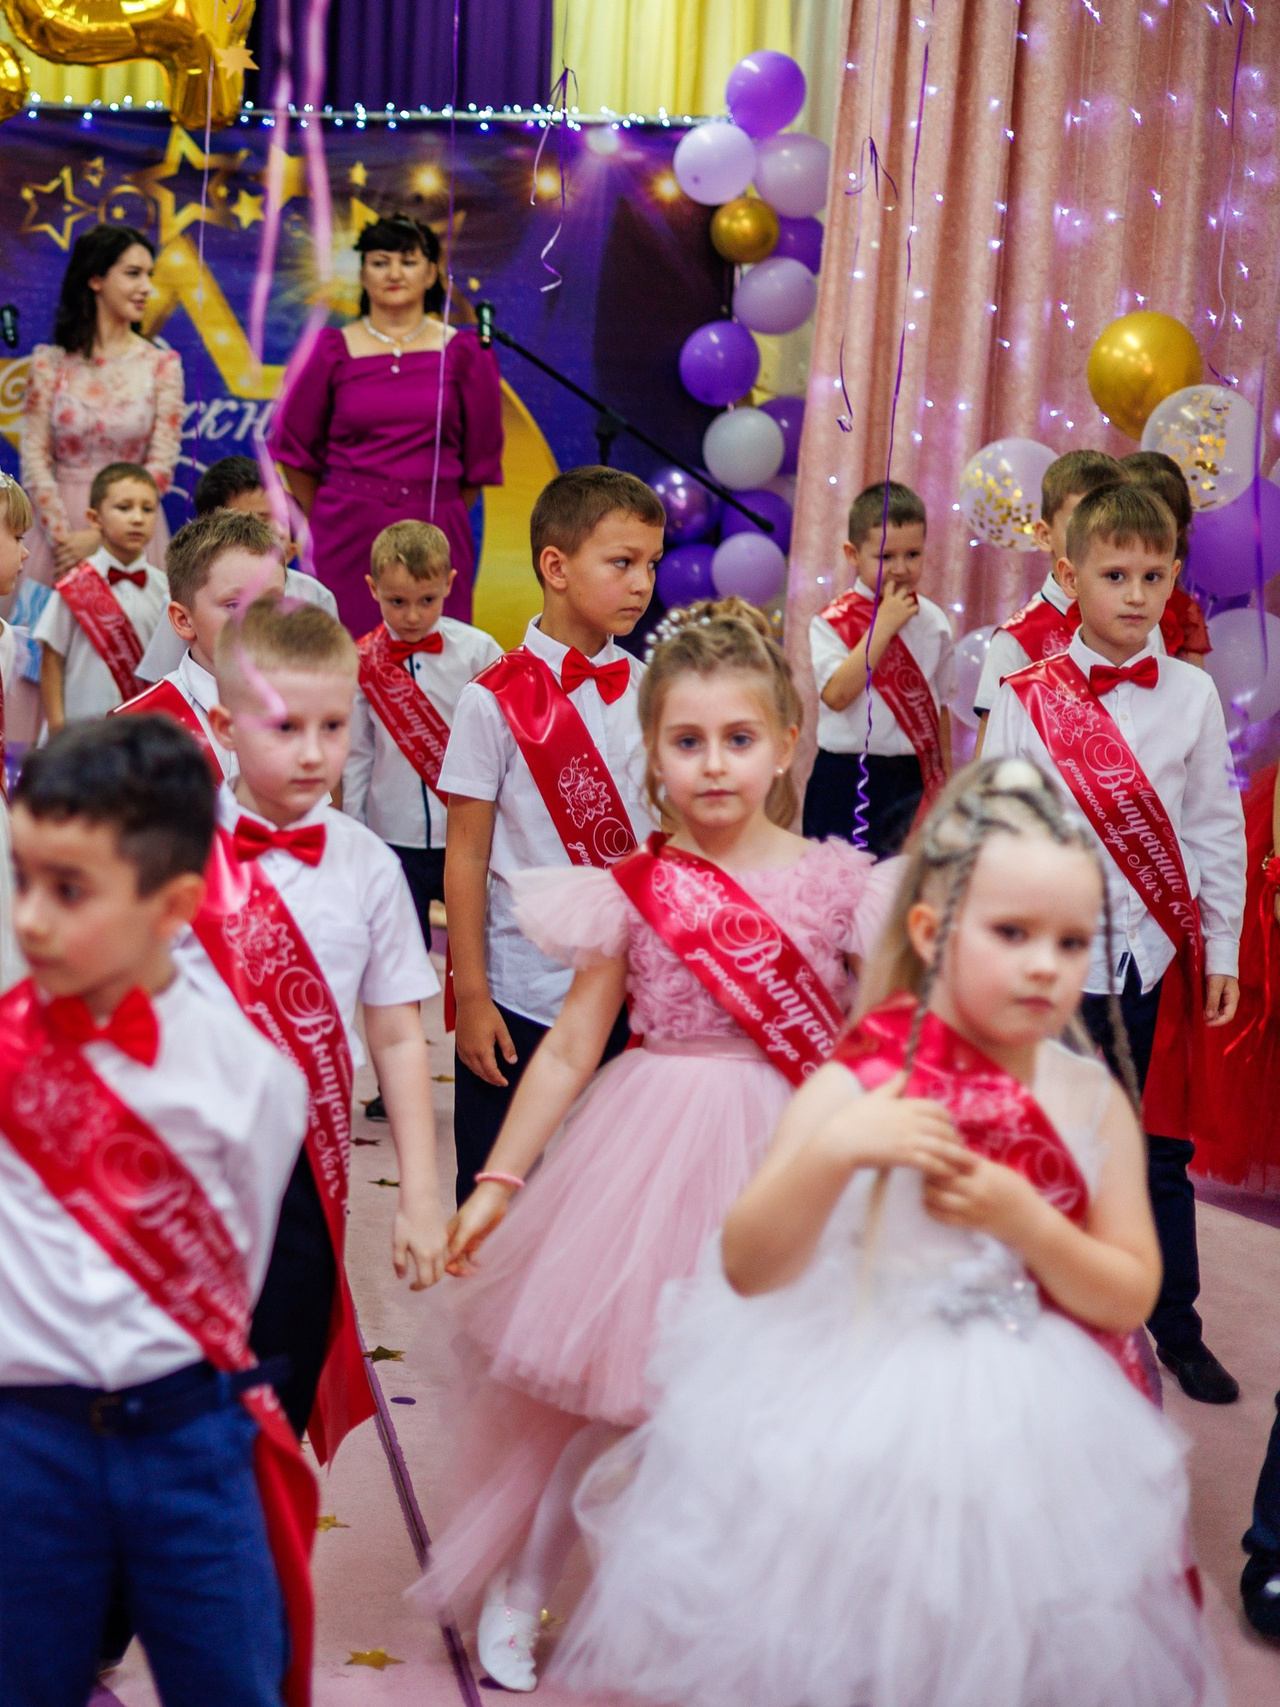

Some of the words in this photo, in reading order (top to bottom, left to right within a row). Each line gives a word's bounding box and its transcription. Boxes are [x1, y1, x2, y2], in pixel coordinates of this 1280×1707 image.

[1058, 757, 1107, 820] детского
[1103, 822, 1128, 854] сада
[1082, 733, 1186, 894] Выпускник
[685, 947, 763, 1021] детского
[762, 1022, 801, 1063] сада
